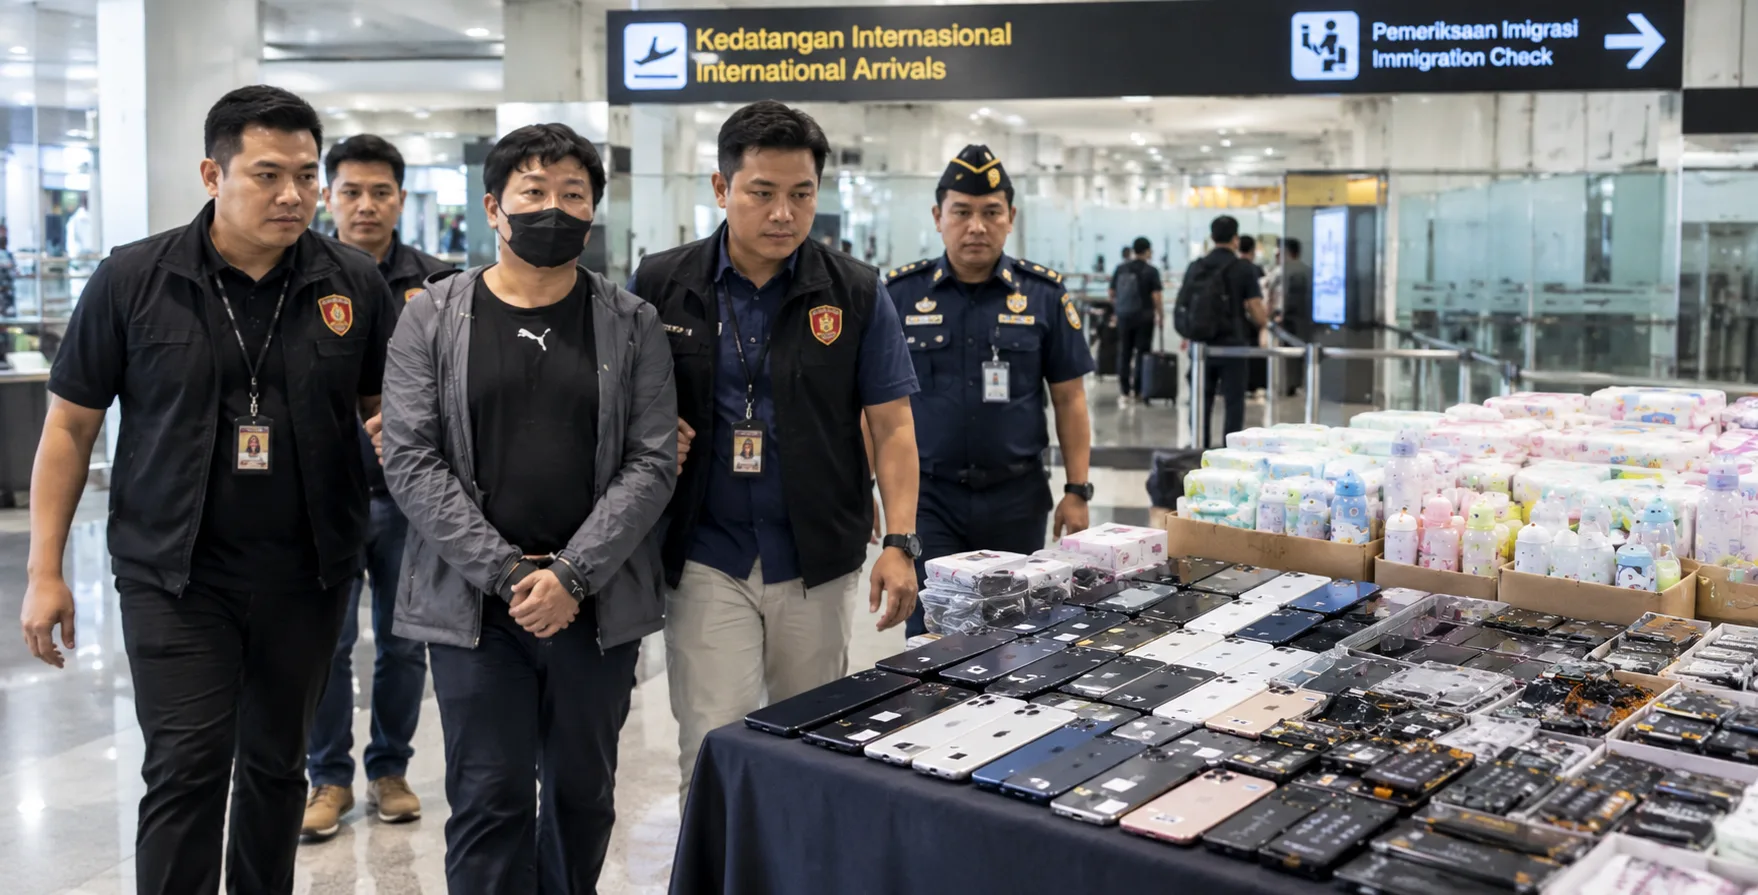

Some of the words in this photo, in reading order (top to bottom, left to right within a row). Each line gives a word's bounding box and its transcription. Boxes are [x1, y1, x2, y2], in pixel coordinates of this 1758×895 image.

[697, 27, 845, 55] Kedatangan
[852, 22, 1012, 48] Internasional
[1372, 20, 1499, 42] Pemeriksaan
[1502, 18, 1579, 43] Imigrasi
[696, 57, 846, 83] International
[853, 56, 947, 81] Arrivals
[1372, 48, 1486, 72] Immigration
[1489, 45, 1554, 67] Check
